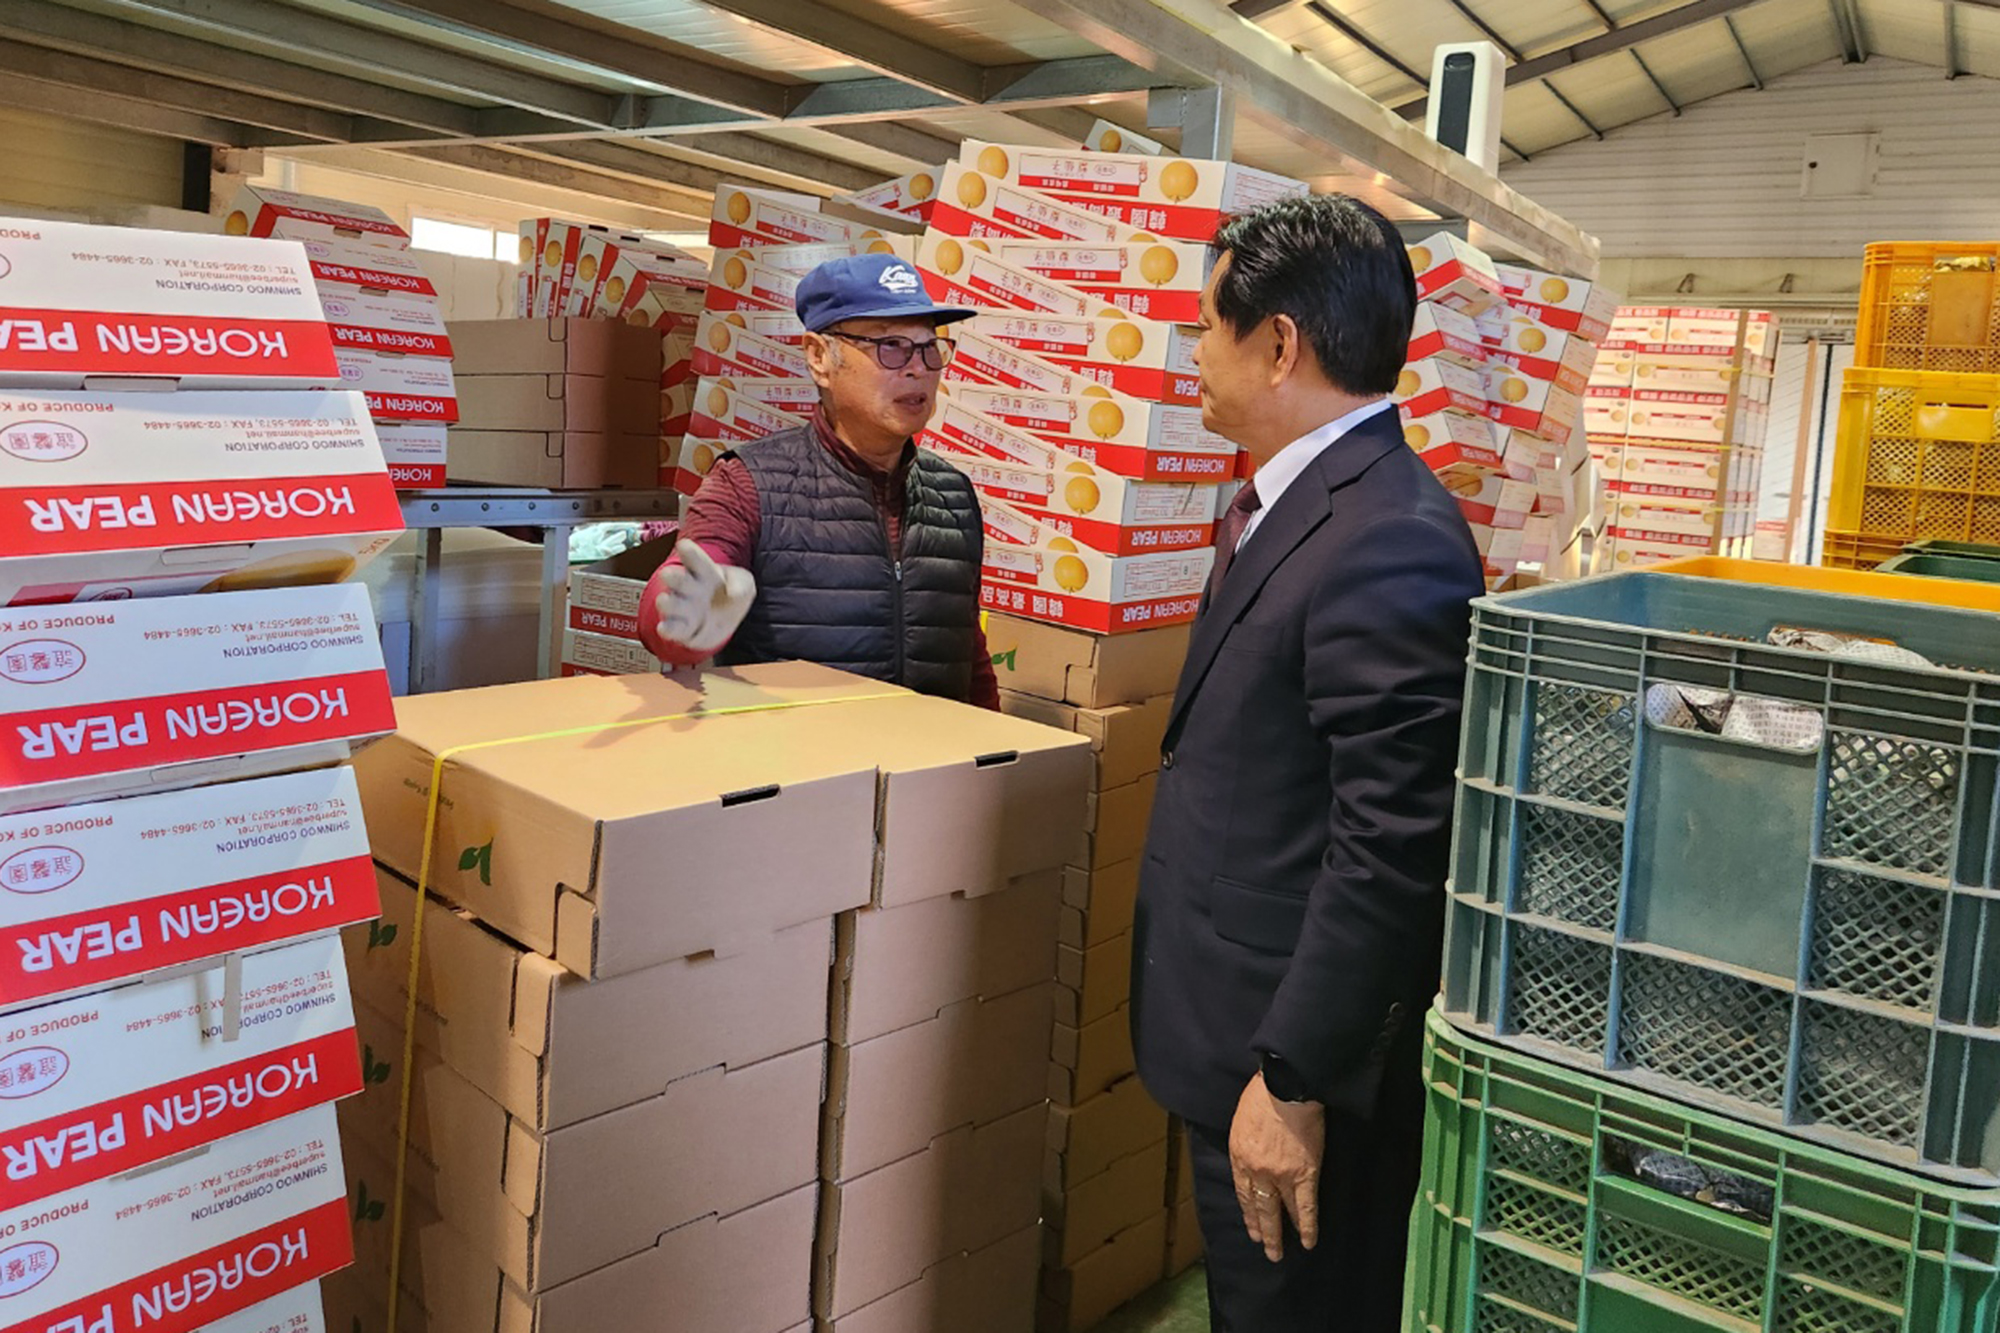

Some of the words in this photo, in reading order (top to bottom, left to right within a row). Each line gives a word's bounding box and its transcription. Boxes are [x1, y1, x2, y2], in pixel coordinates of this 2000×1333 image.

[288, 208, 326, 222] PEAR
[164, 258, 186, 267] FAX
[274, 265, 295, 275] TEL
[317, 264, 356, 279] PEAR
[155, 279, 243, 294] CORPORATION
[360, 271, 419, 288] KOREAN
[247, 285, 302, 296] SHINWOO
[96, 323, 288, 358] KOREAN
[335, 327, 373, 342] PEAR
[376, 332, 435, 349] KOREAN
[1174, 379, 1200, 396] PEAR
[17, 402, 37, 412] OF
[43, 402, 114, 413] PRODUCE
[386, 398, 445, 414] KOREAN
[232, 419, 253, 429] FAX
[338, 418, 358, 427] TEL
[224, 440, 309, 452] CORPORATION
[312, 438, 364, 451] SHINWOO
[1156, 456, 1184, 471] PEAR
[1185, 459, 1225, 473] KOREAN
[171, 485, 356, 524] KOREAN
[23, 494, 157, 532] PEAR
[1132, 531, 1159, 546] PEAR
[1160, 529, 1202, 543] KOREAN
[1123, 606, 1151, 621] PEAR
[1155, 599, 1199, 617] KOREAN
[17, 620, 37, 629] OF
[43, 614, 115, 627] PRODUCE
[337, 612, 358, 622] TEL
[582, 613, 607, 627] PEAR
[231, 622, 253, 633] FAX
[310, 634, 364, 648] SHINWOO
[223, 640, 308, 658] CORPORATION
[165, 687, 349, 740] KOREAN
[17, 712, 148, 760] PEAR
[325, 798, 345, 809] TEL
[44, 815, 113, 835] PRODUCE
[224, 813, 246, 827] FAX
[19, 826, 39, 837] OF
[300, 820, 350, 838] SHINWOO
[216, 830, 297, 853] CORPORATION
[159, 875, 335, 942] KOREAN
[16, 916, 143, 973] PEAR
[311, 969, 332, 981] TEL
[210, 998, 225, 1008] AX
[285, 993, 336, 1015] SHINWOO
[30, 1010, 99, 1036] PRODUCE
[6, 1029, 25, 1042] OF
[143, 1052, 319, 1138] KOREAN
[1, 1112, 126, 1181] PEAR
[304, 1140, 323, 1152] TEL
[200, 1175, 222, 1191] FAX
[276, 1163, 327, 1189] SHINWOO
[191, 1183, 273, 1221] CORPORATION
[20, 1199, 89, 1231] PRODUCE
[133, 1228, 309, 1327] KOREAN
[287, 1313, 307, 1327] TEL
